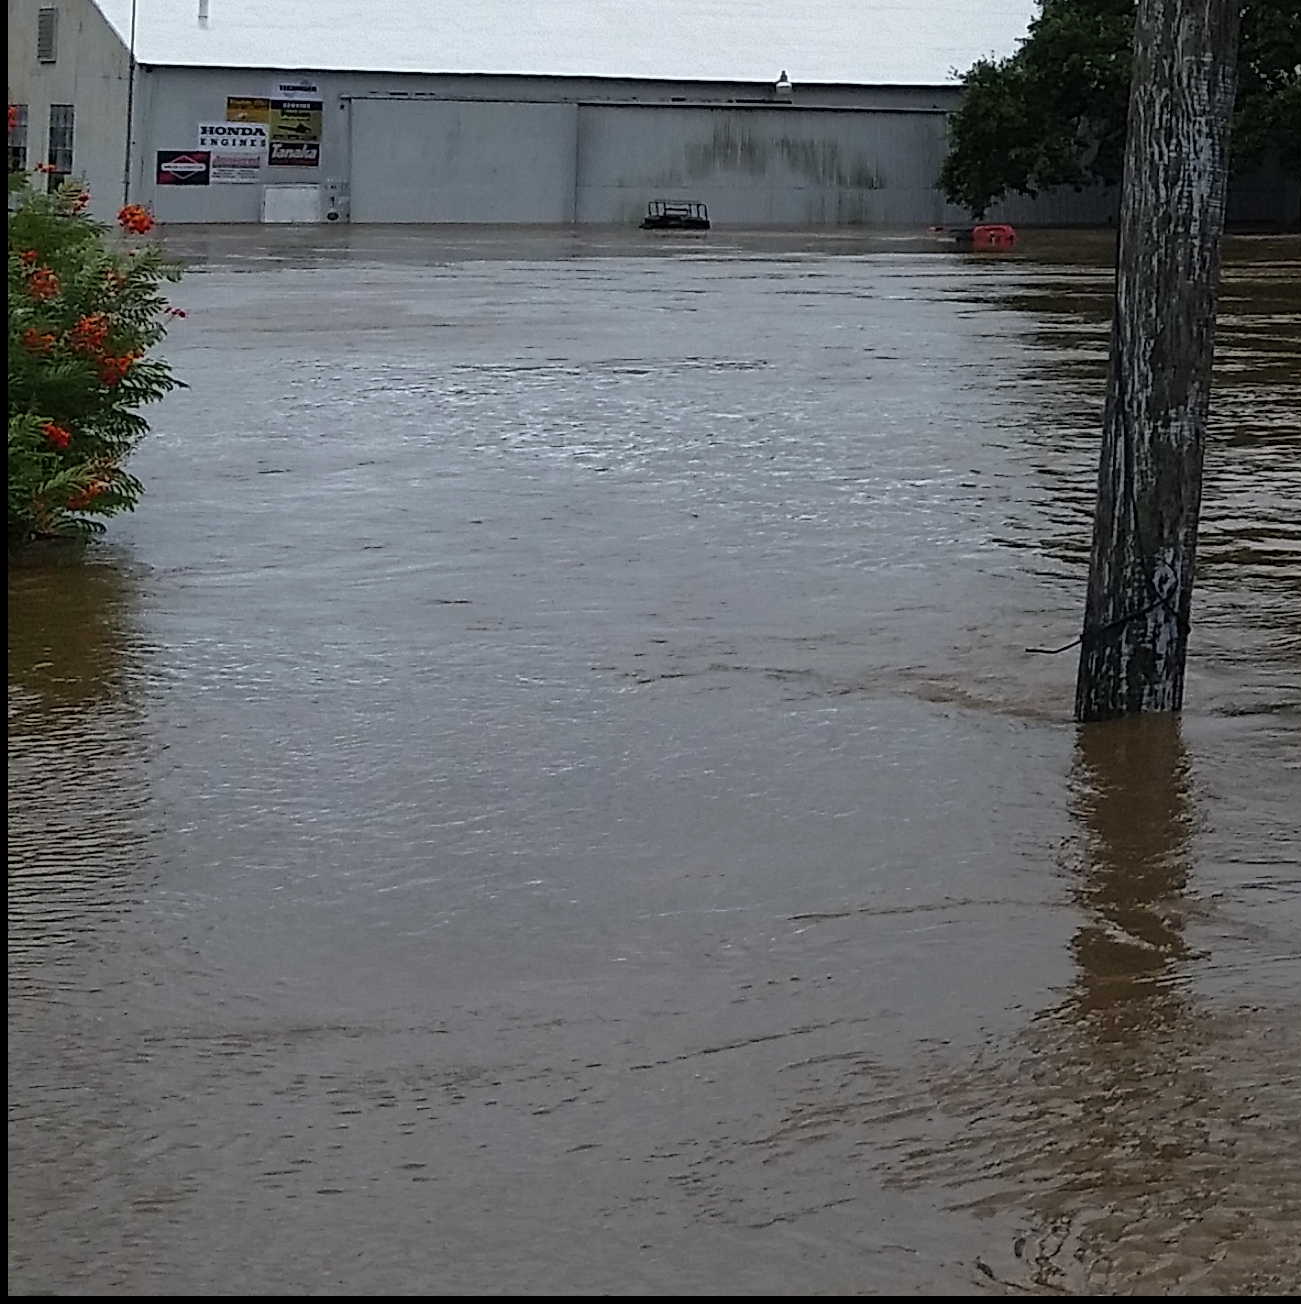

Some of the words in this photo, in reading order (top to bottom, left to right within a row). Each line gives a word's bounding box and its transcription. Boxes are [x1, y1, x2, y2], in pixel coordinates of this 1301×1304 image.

[200, 126, 266, 137] HONDA
[200, 138, 266, 147] ENGINES
[272, 143, 318, 159] Tanaka
